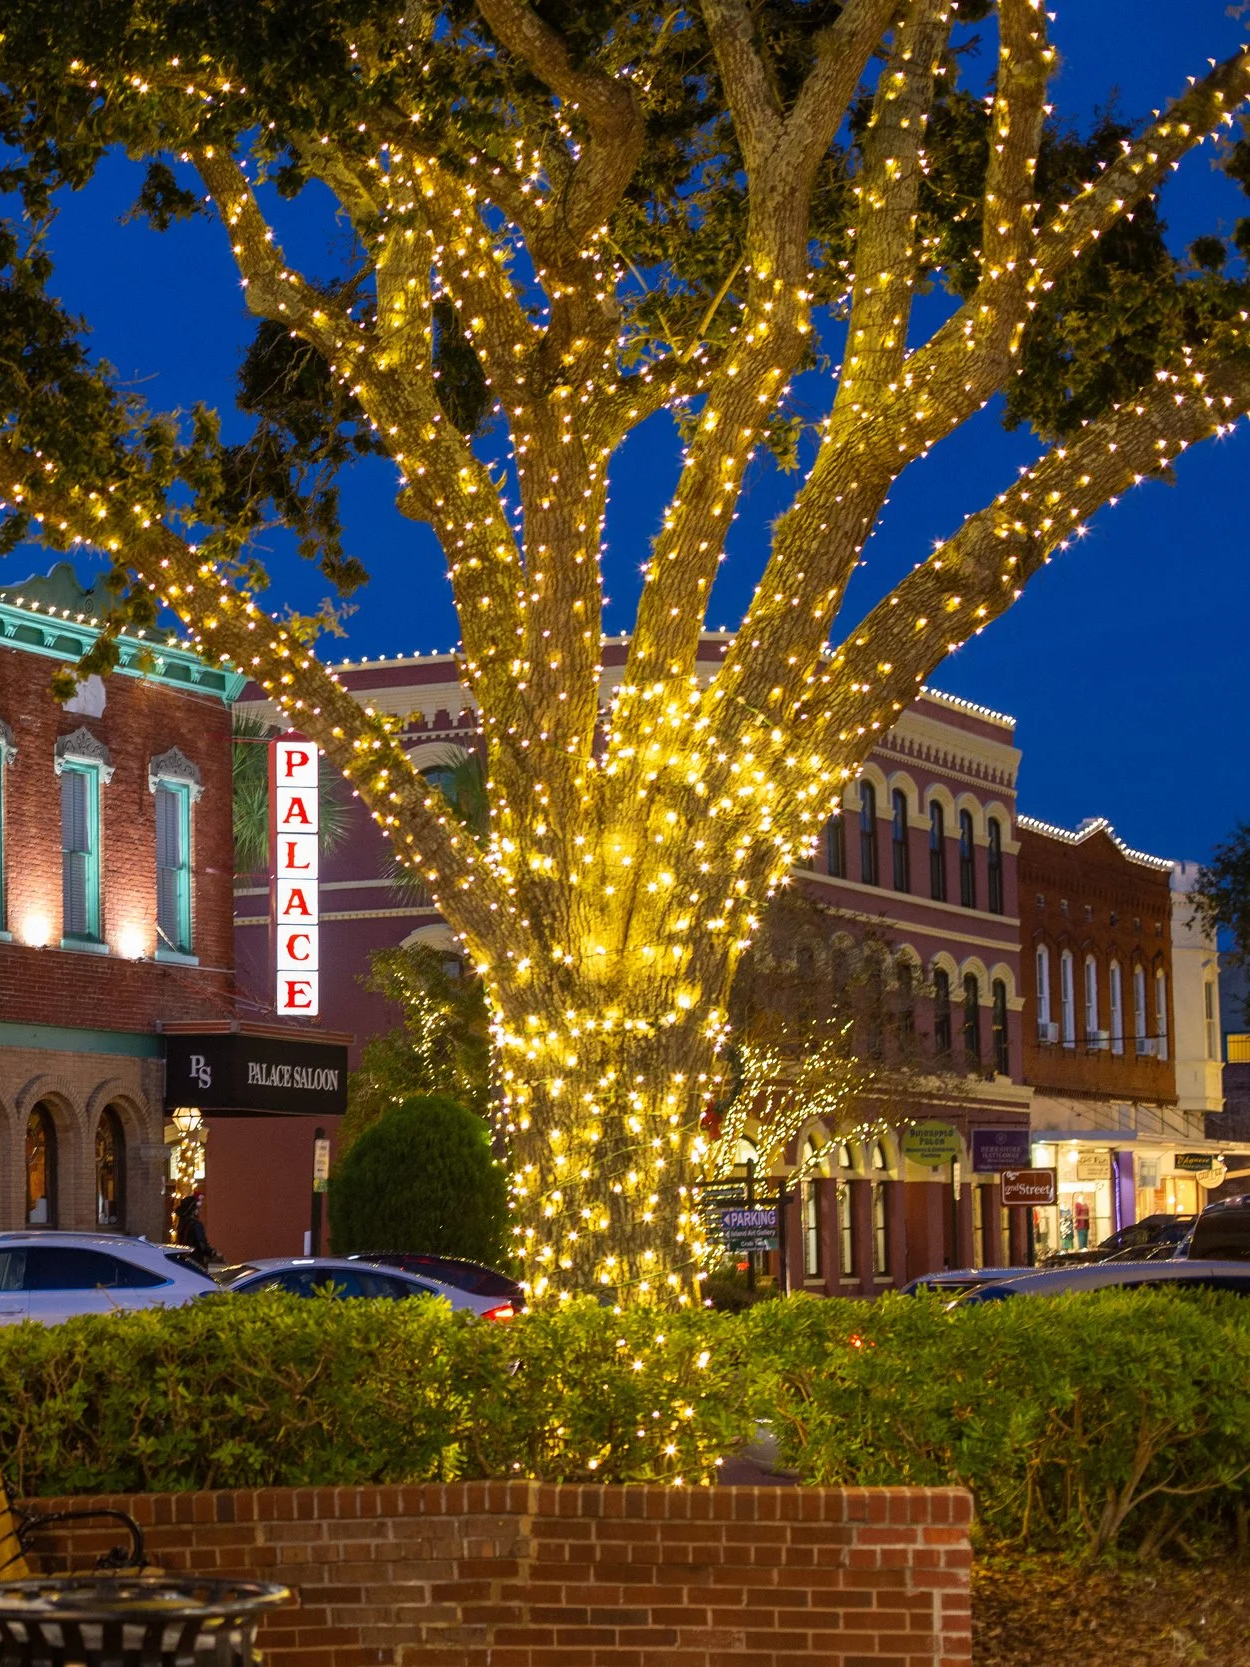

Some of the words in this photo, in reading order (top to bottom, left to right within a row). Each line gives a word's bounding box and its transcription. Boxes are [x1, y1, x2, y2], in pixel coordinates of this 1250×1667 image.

[282, 750, 312, 1008] PALACE
[247, 1062, 292, 1088] PALACE
[293, 1067, 339, 1091] SALOON
[731, 1210, 776, 1227] PARKING
[757, 1229, 776, 1237] Gallery
